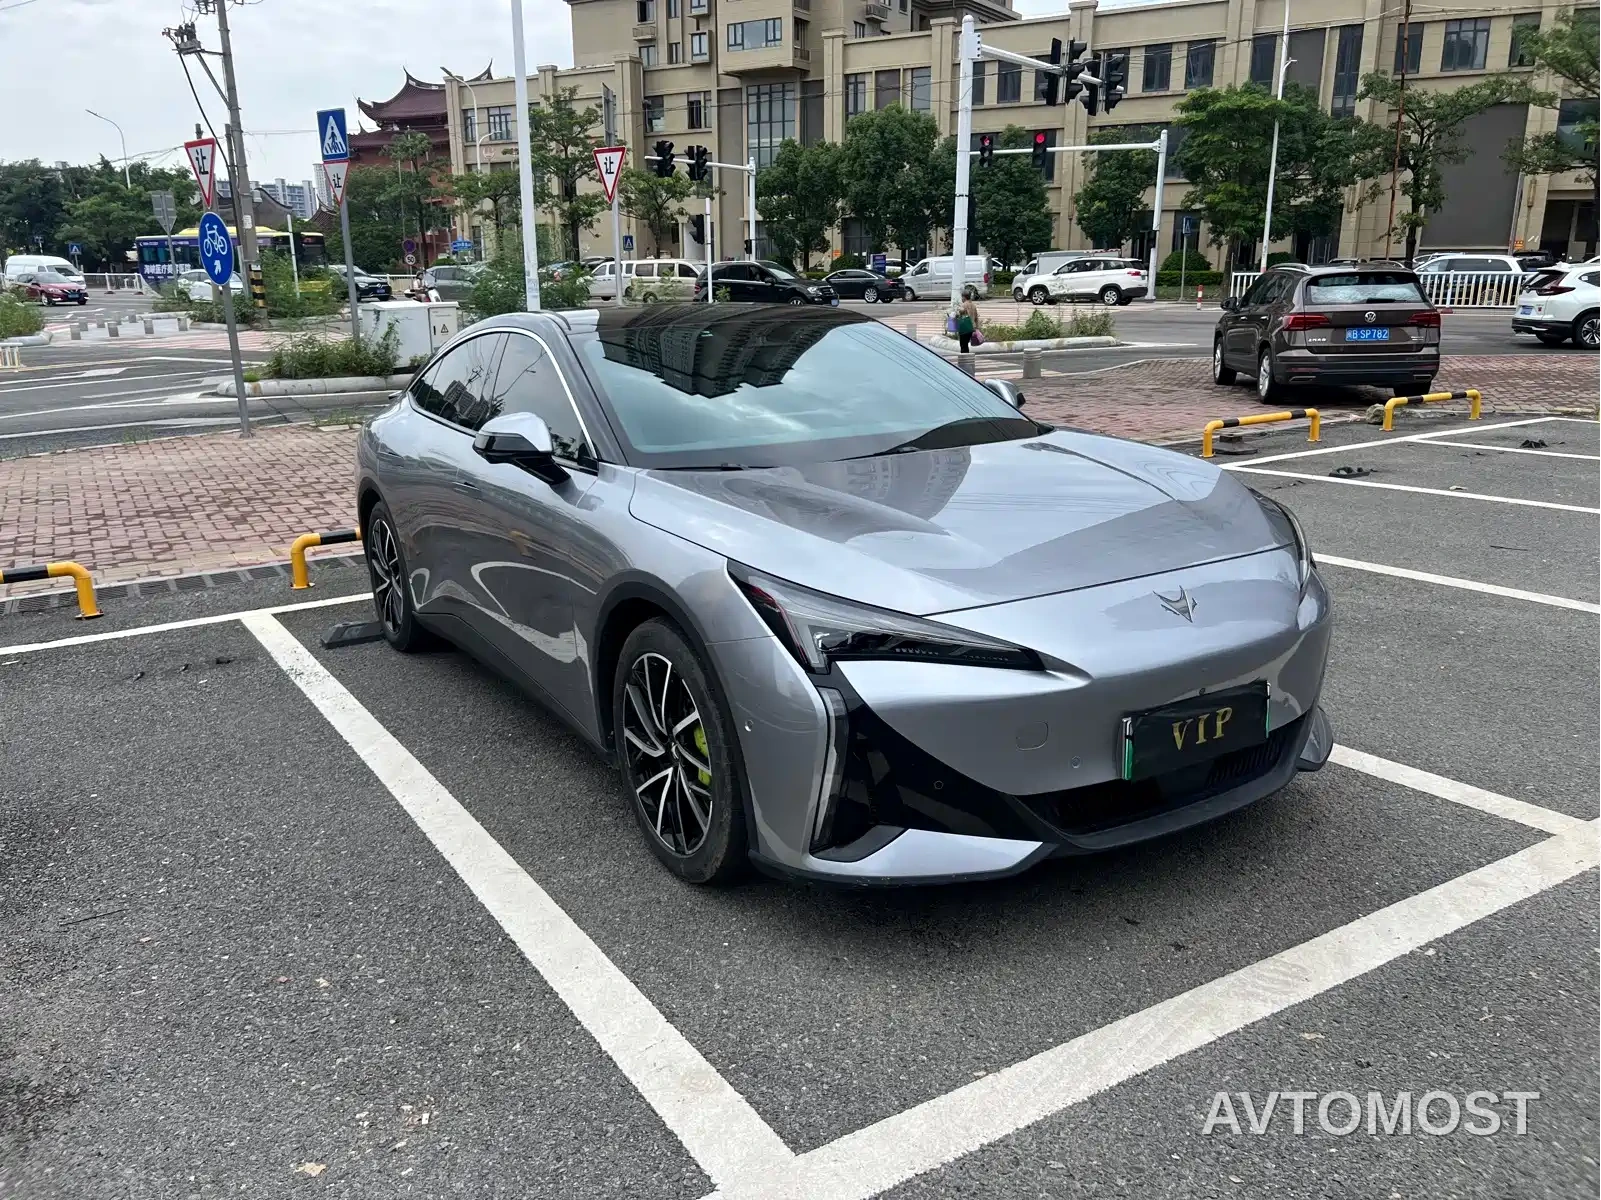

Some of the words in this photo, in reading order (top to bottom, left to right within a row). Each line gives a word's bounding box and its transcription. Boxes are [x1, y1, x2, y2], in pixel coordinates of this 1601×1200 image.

[195, 148, 209, 175] 让
[604, 156, 614, 174] 让
[332, 173, 342, 189] 让
[1171, 707, 1233, 750] VIP
